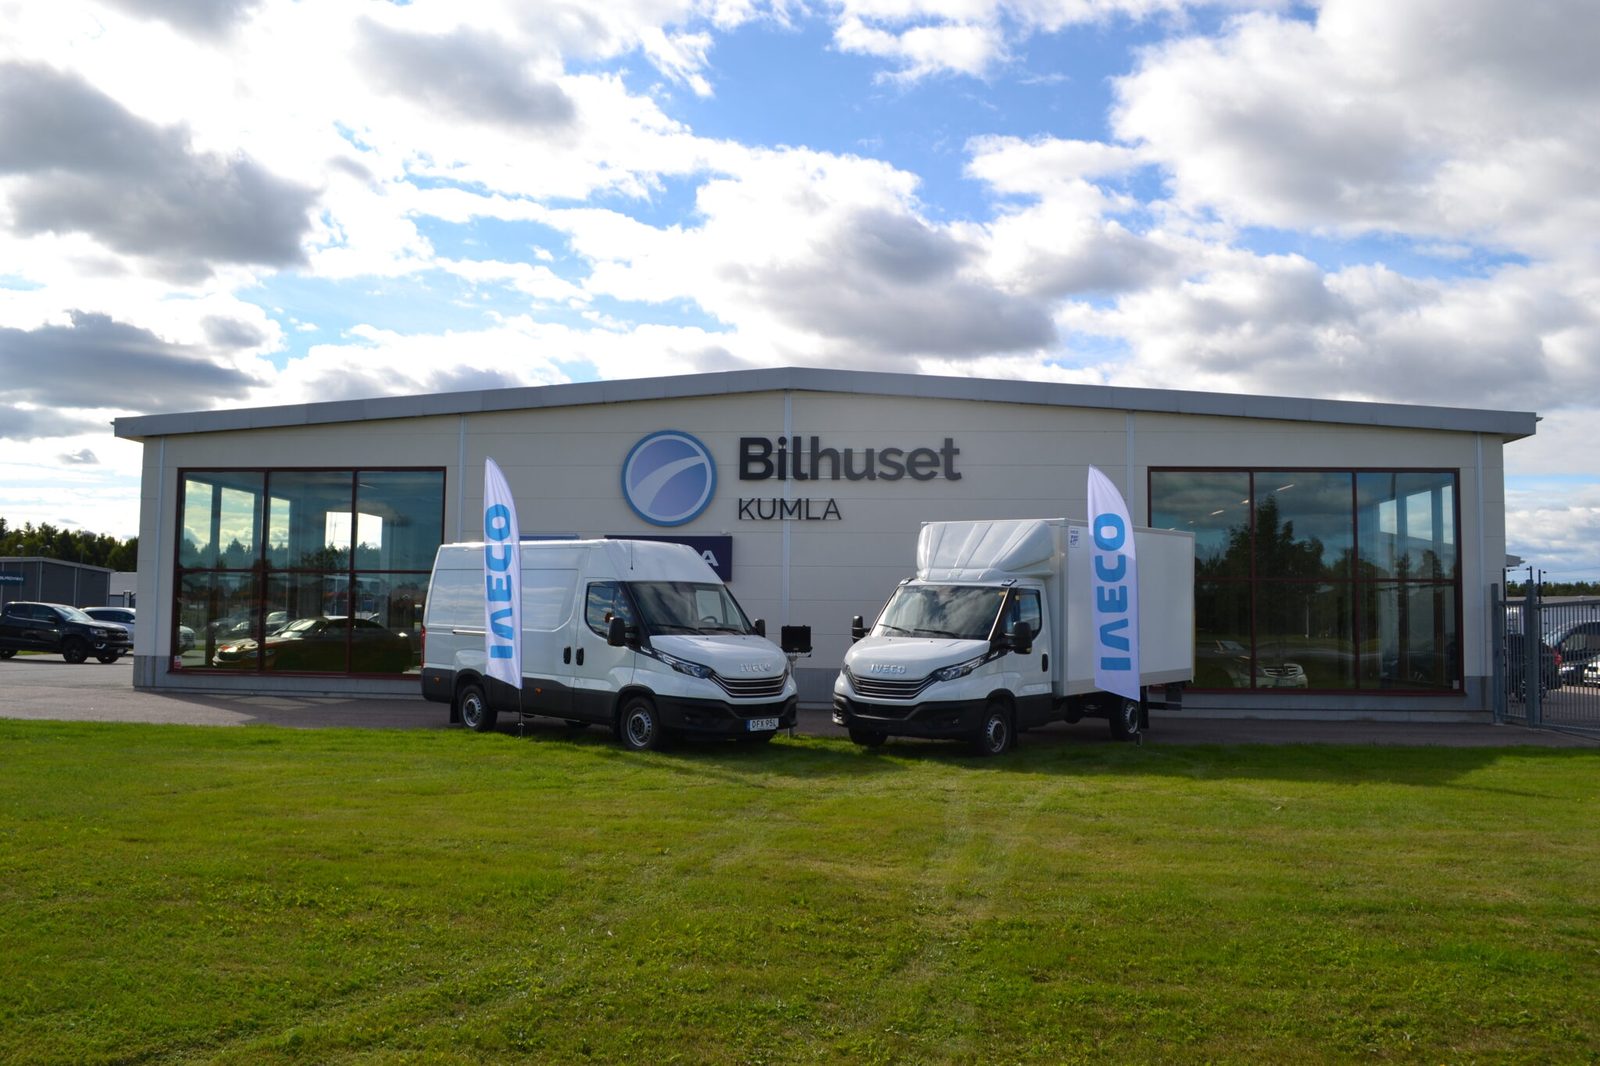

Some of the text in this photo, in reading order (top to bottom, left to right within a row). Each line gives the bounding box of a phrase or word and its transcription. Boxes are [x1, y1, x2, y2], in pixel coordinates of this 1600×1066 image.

[739, 436, 962, 481] Bilhuset
[738, 498, 842, 520] KUMLA
[740, 663, 771, 672] IVECO
[870, 663, 906, 674] IVECO
